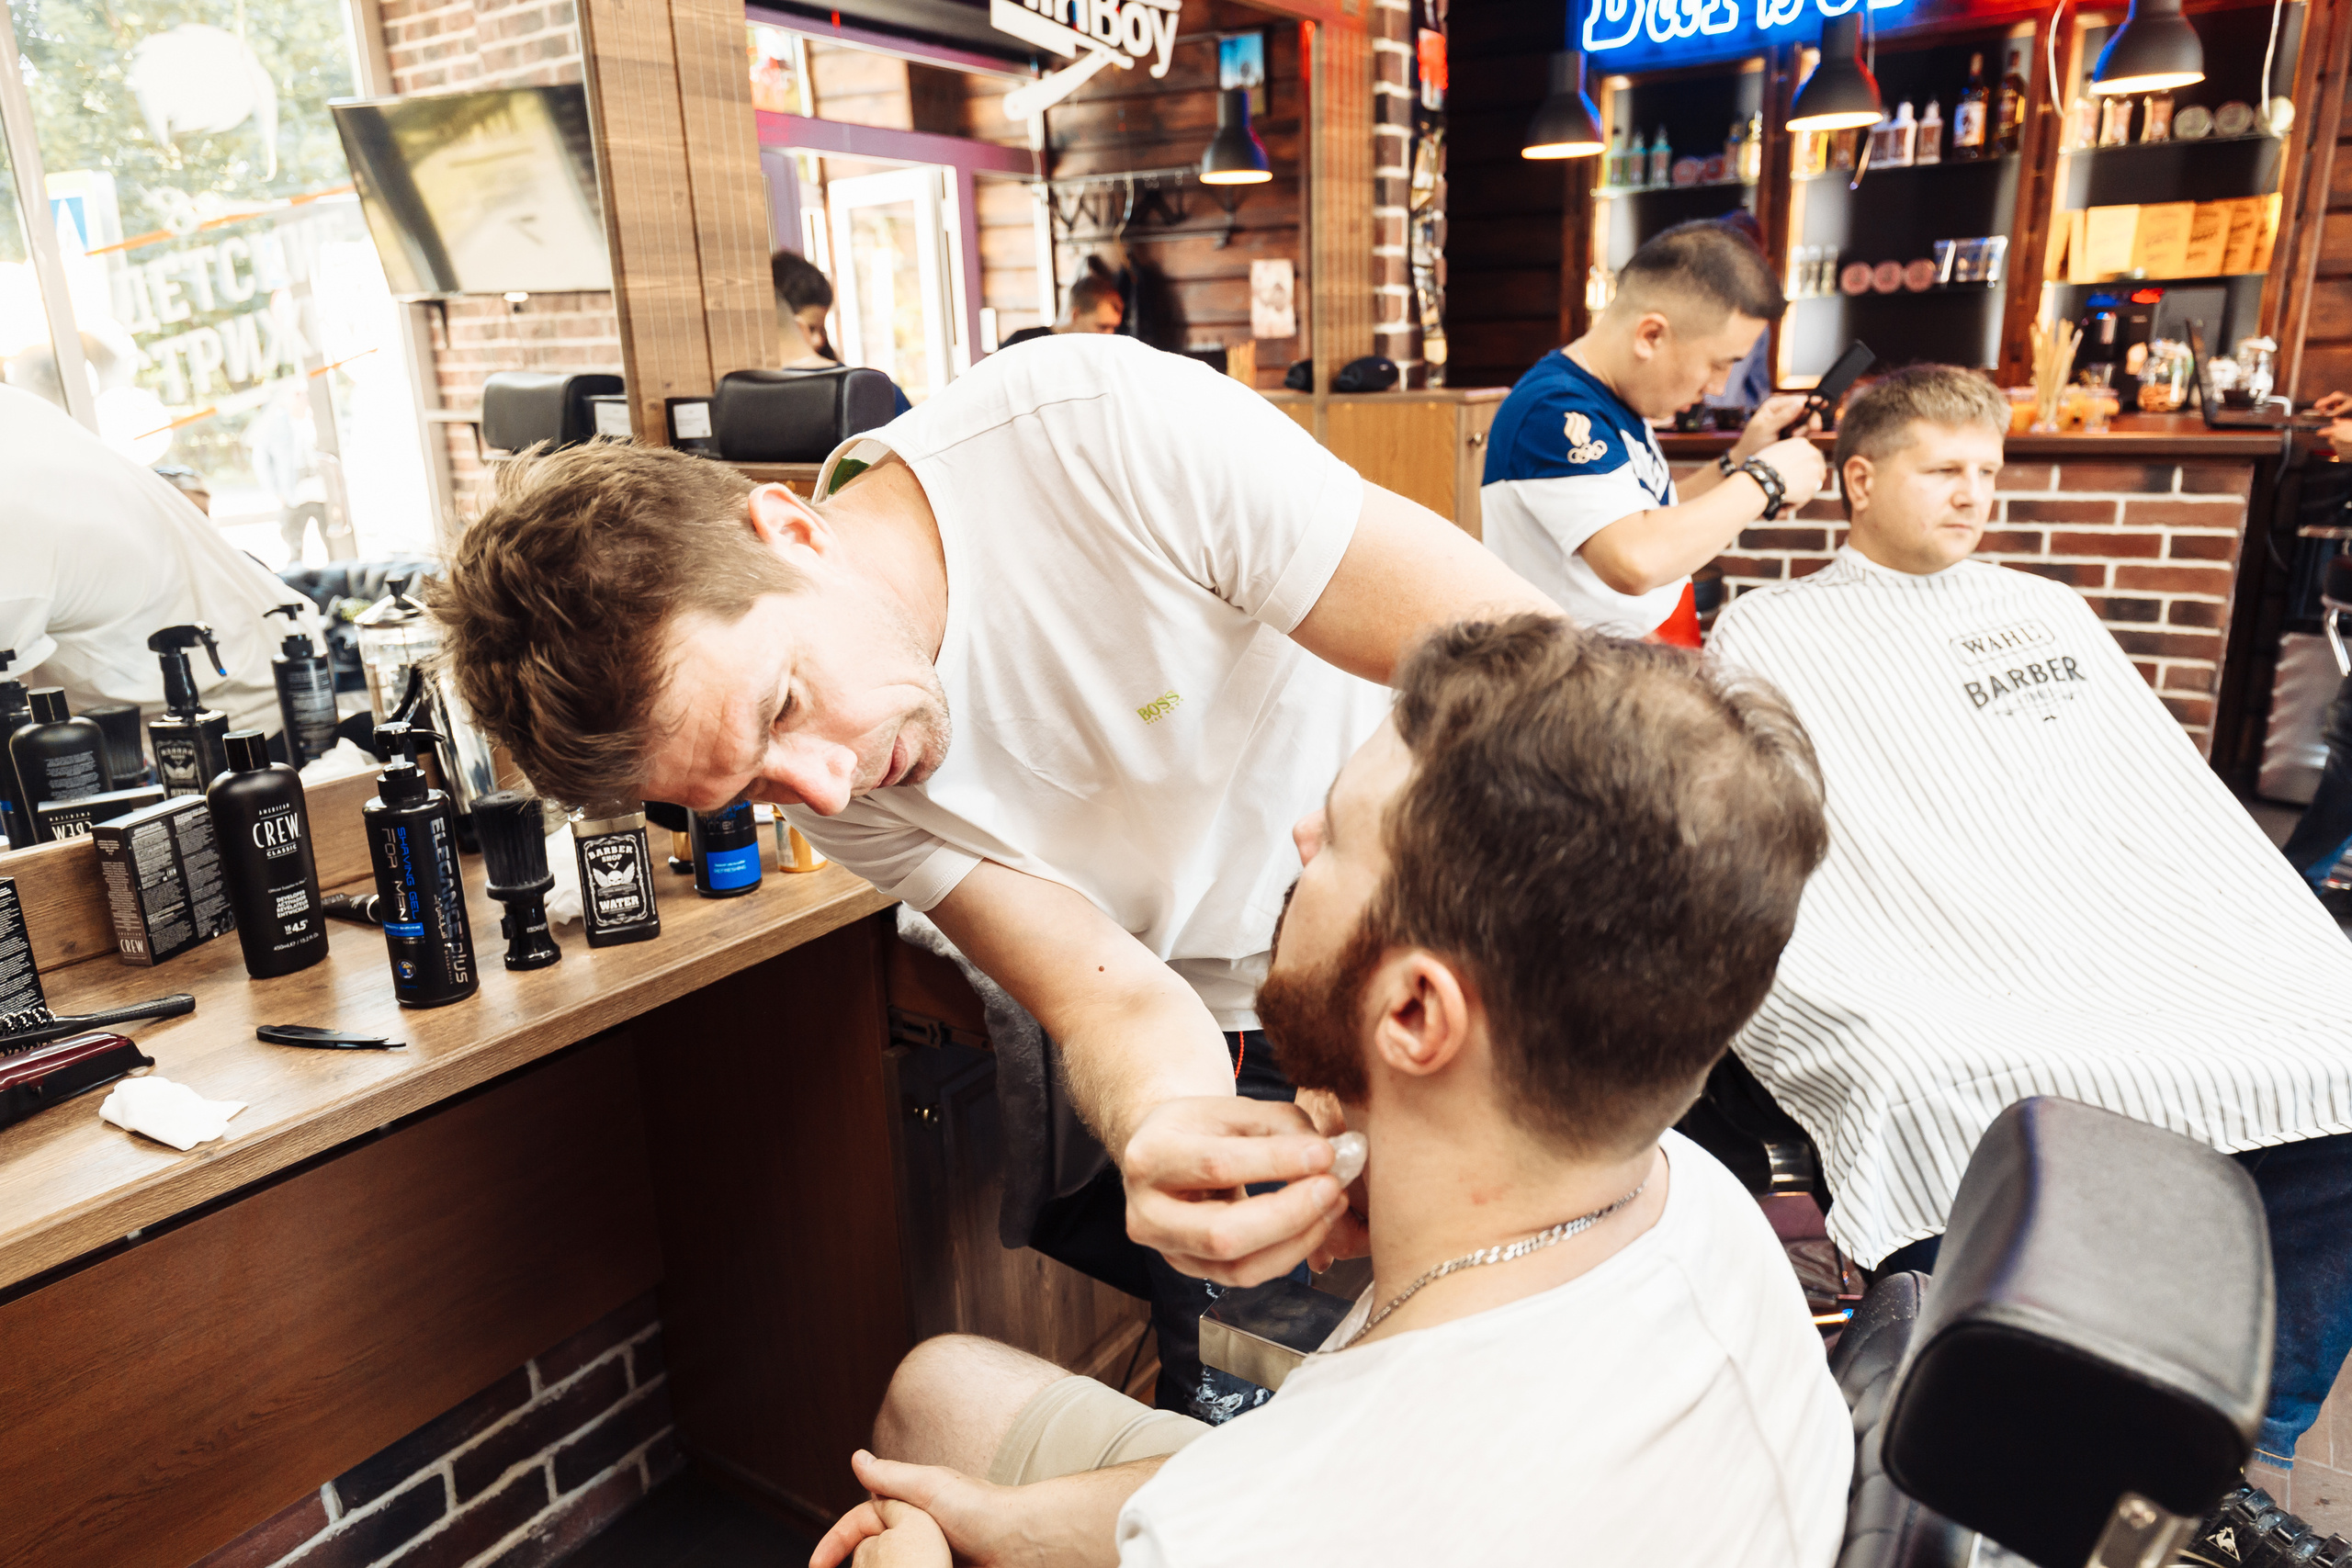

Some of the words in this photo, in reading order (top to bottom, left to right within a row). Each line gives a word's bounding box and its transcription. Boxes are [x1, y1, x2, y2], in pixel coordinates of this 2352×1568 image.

[1962, 626, 2041, 654] WAHL
[1963, 656, 2086, 709] BARBER
[1136, 690, 1180, 721] BOSS
[253, 812, 300, 849] CREW
[266, 843, 297, 857] CLASSIC
[588, 845, 633, 861] BARBER
[601, 853, 622, 863] SHOP
[381, 828, 399, 869] FOR
[392, 880, 409, 921] MEN
[397, 827, 415, 886] SHAVING
[408, 891, 420, 919] GEL
[429, 817, 463, 938] ELEGANCE
[599, 896, 639, 910] WATER
[120, 939, 144, 953] CREW
